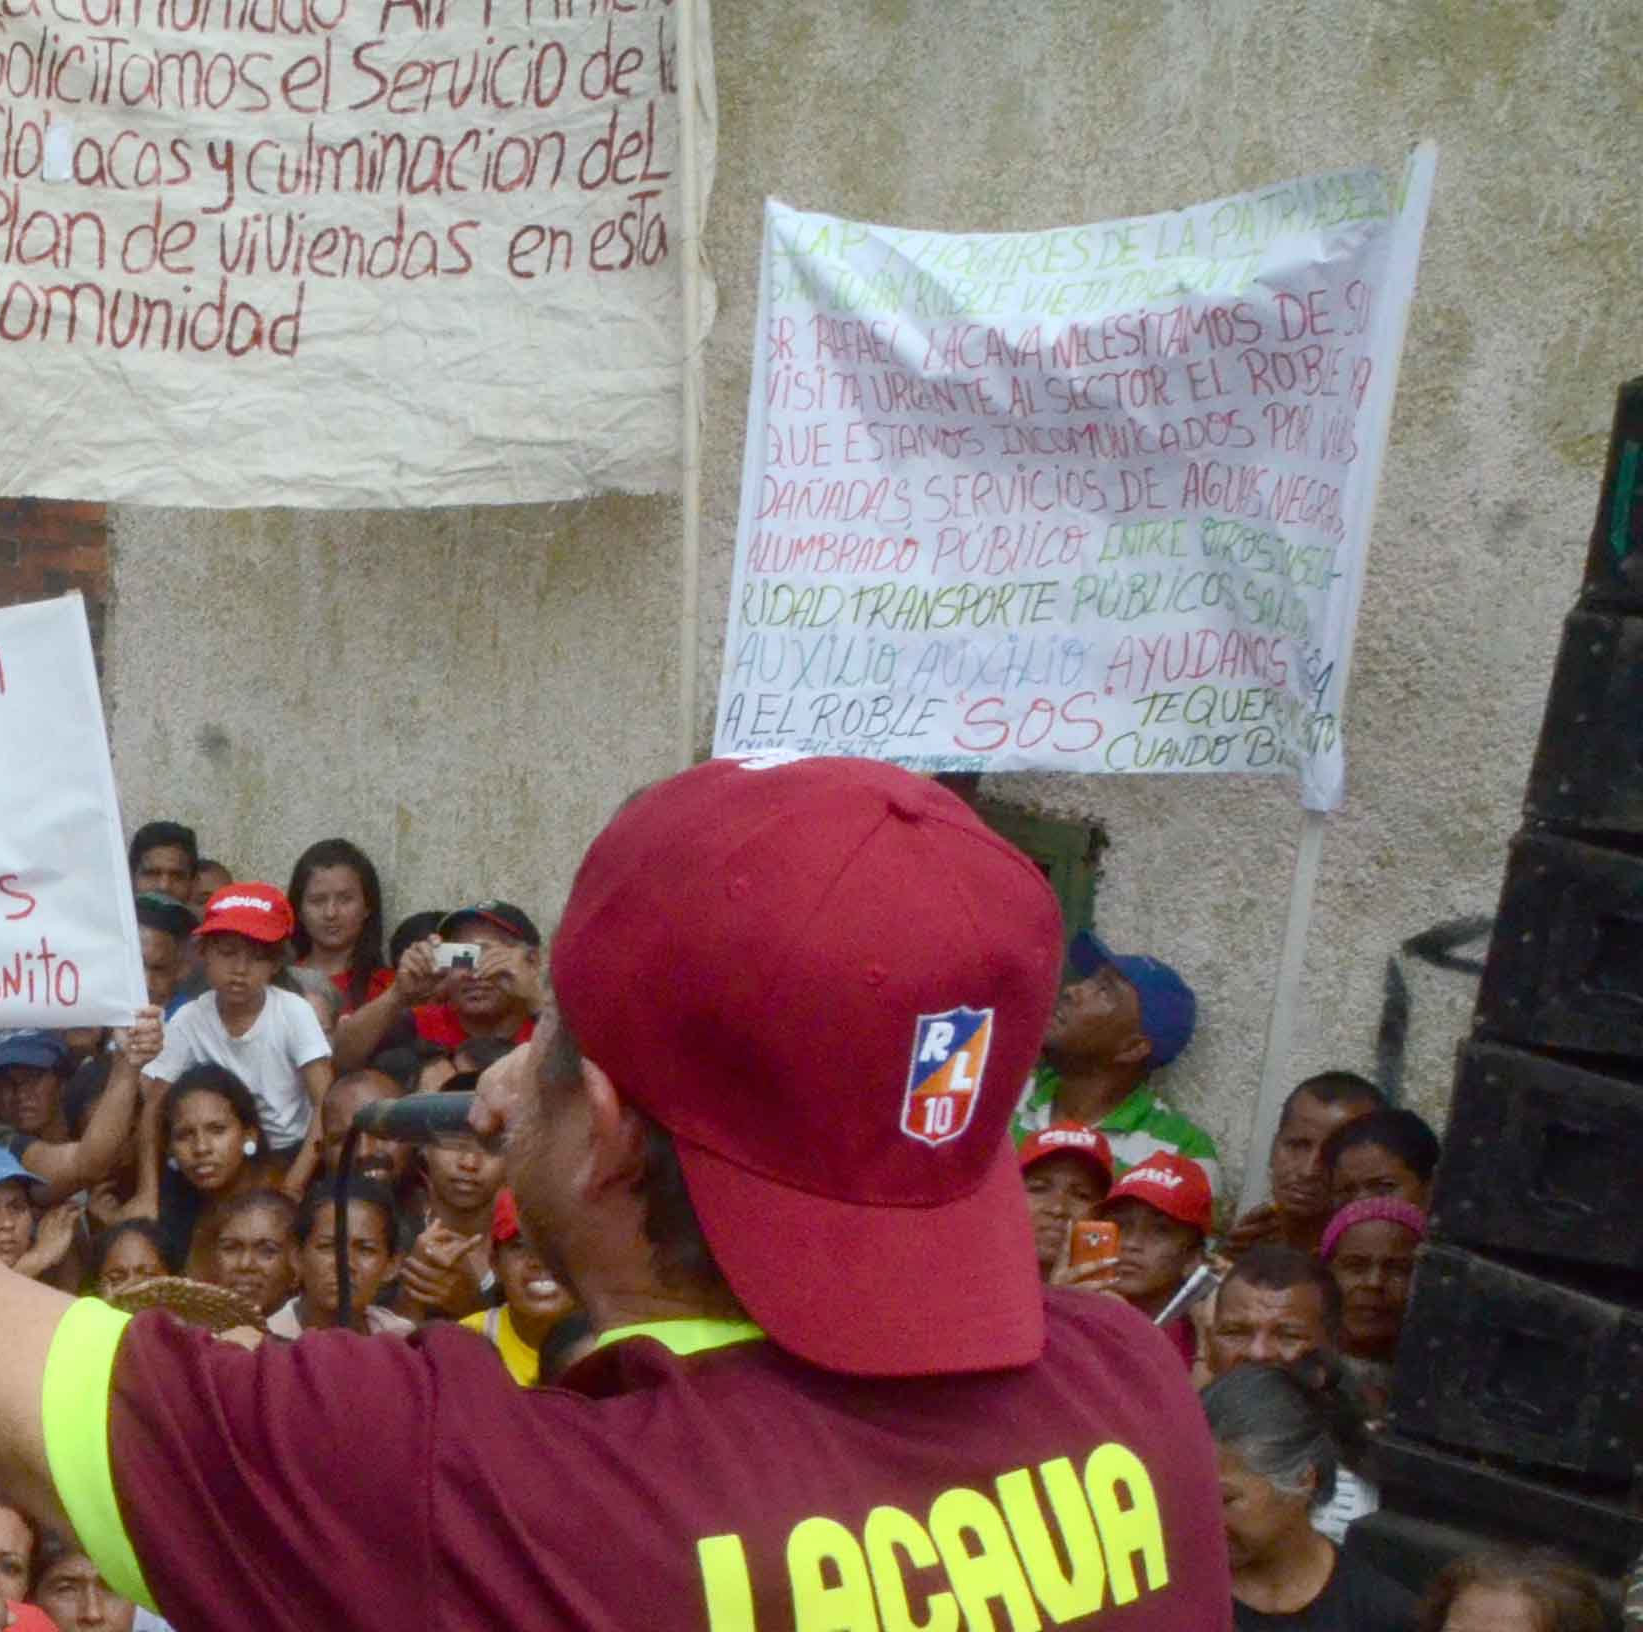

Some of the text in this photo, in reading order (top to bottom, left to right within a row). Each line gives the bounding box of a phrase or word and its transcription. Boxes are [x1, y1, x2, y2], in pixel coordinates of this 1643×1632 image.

[203, 137, 235, 214] y
[246, 122, 565, 198] culminacion
[121, 201, 198, 276] de
[508, 222, 572, 280] en
[918, 1021, 955, 1062] R
[949, 1051, 972, 1091] L
[923, 1096, 955, 1135] 10
